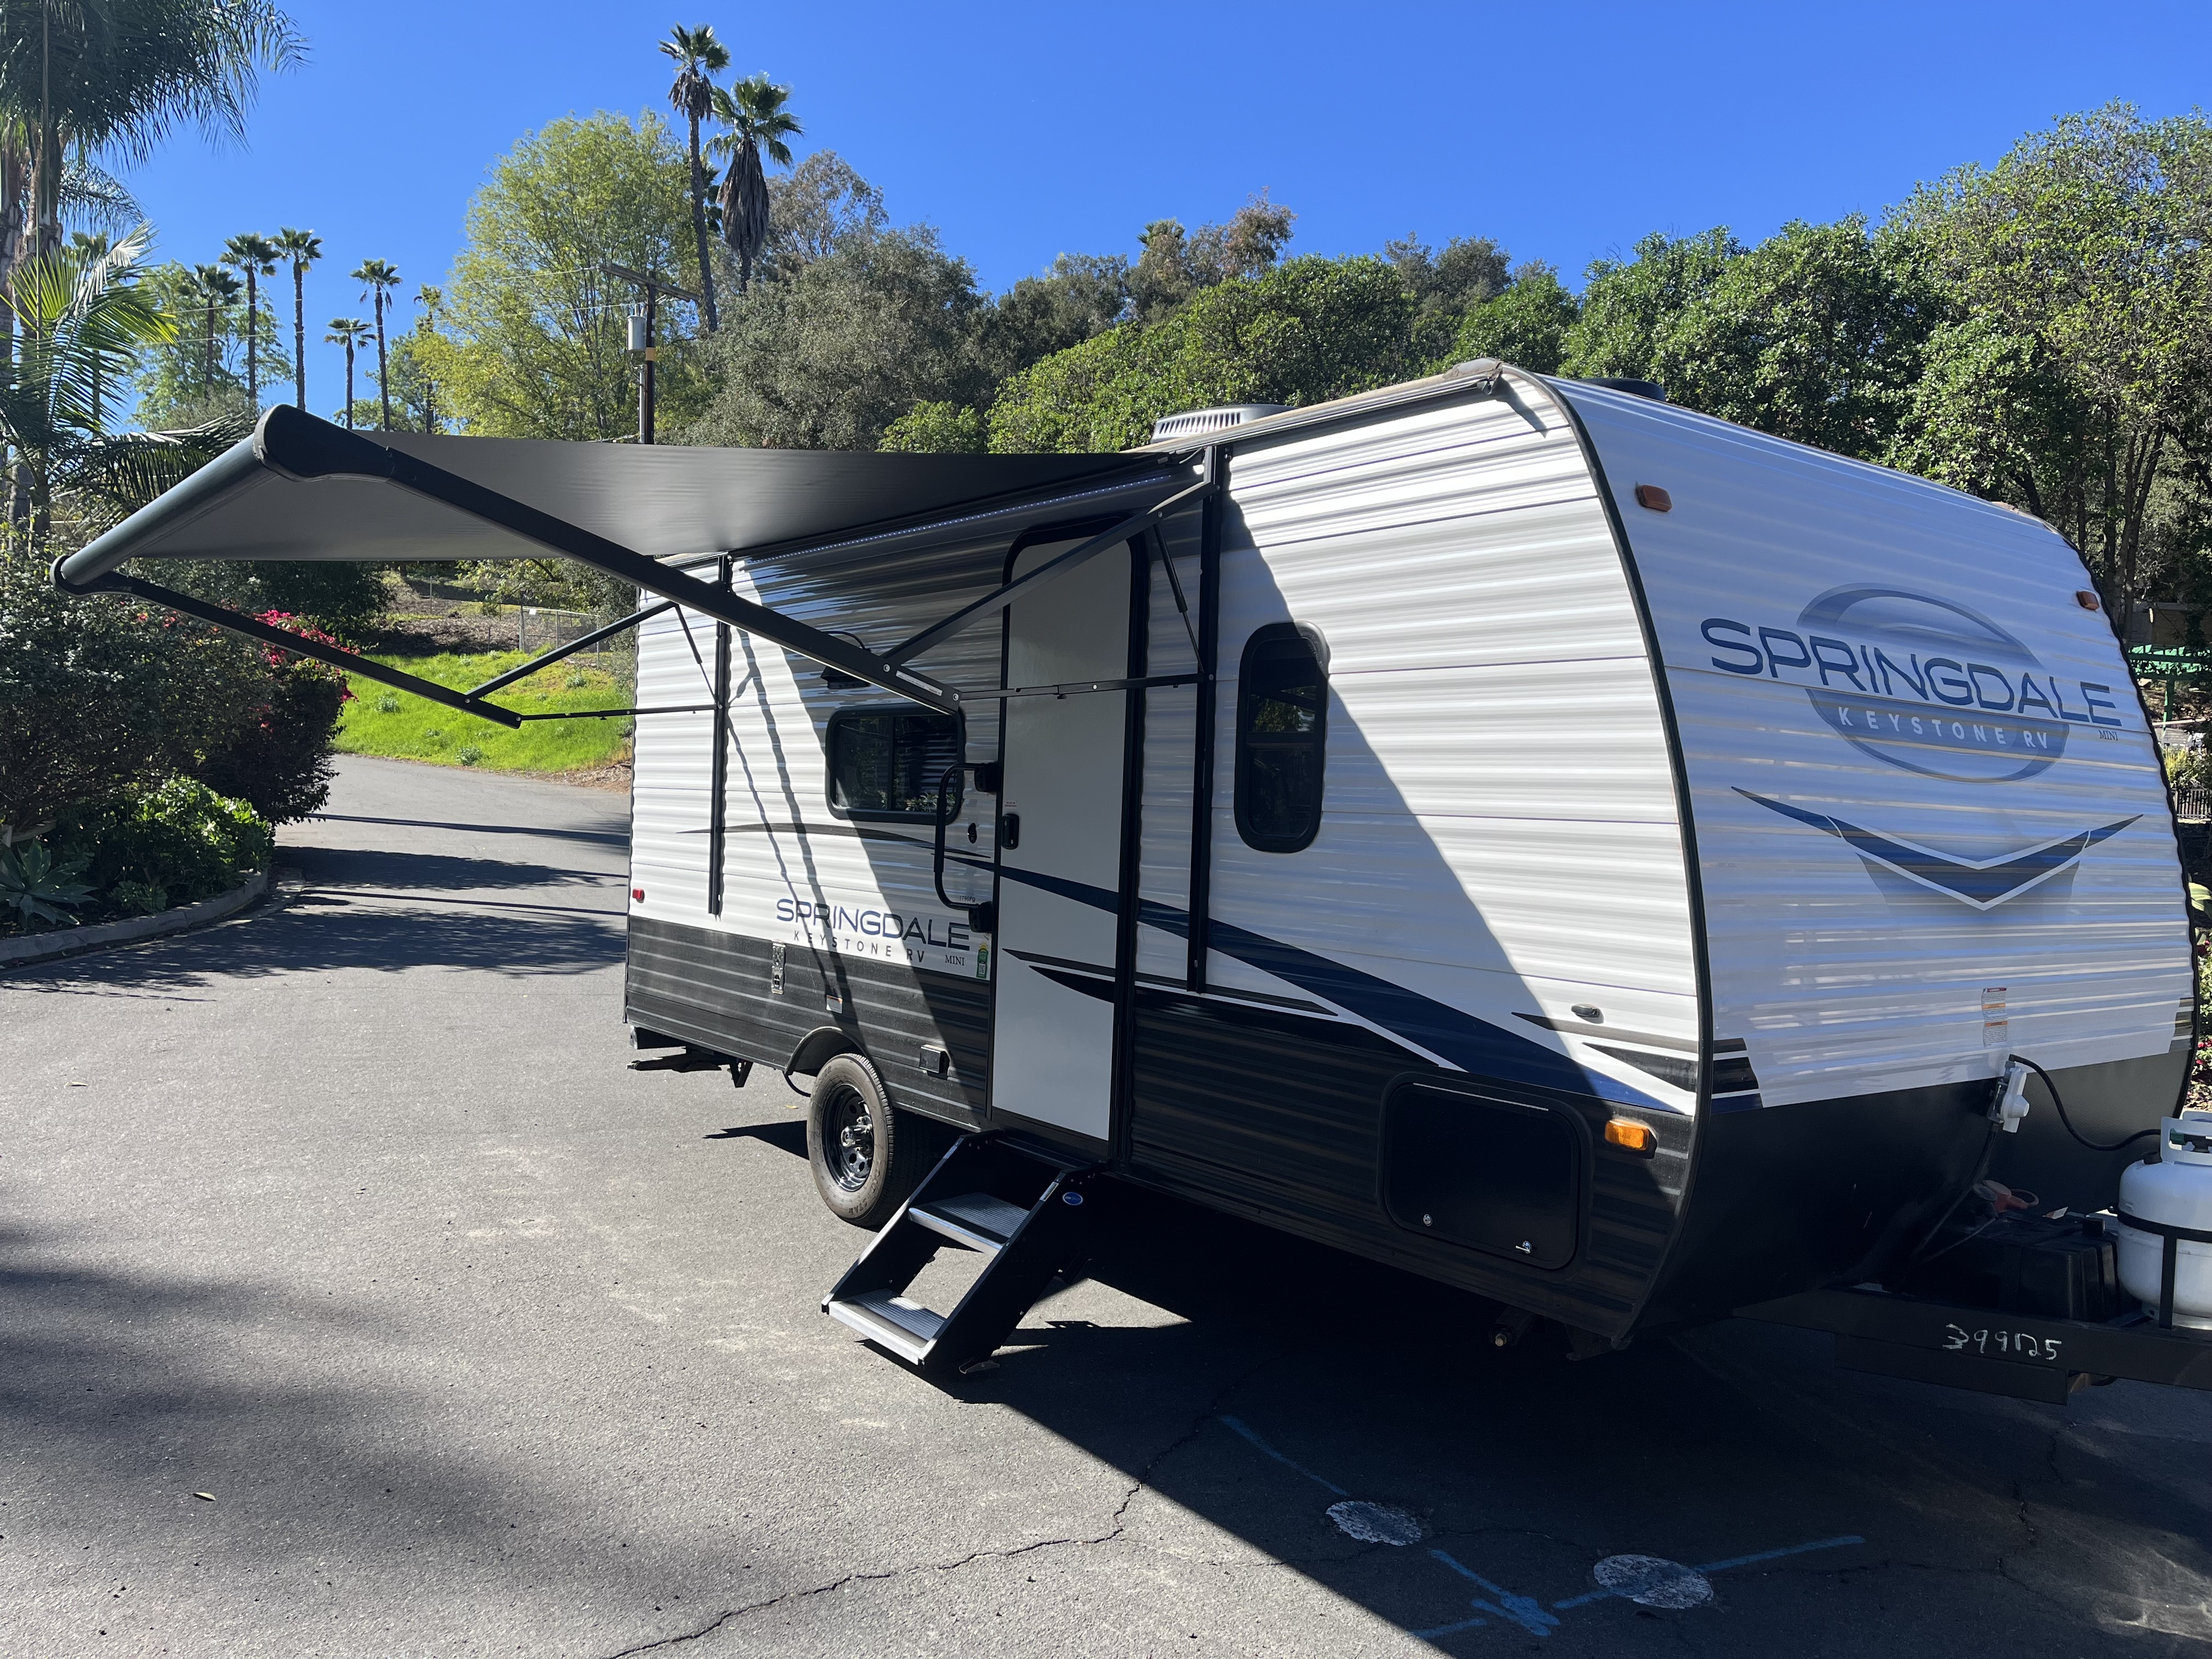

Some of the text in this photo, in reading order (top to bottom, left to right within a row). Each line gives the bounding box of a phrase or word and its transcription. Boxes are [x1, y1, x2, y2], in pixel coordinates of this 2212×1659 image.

[1701, 618, 2121, 726] SPRINGDALE
[1838, 707, 2048, 749] KEYSTONE RV
[2098, 729, 2119, 741] MINI
[776, 899, 970, 951] SPRINGDALE
[794, 930, 924, 963] KEYSTONE RV
[945, 954, 965, 967] MINI
